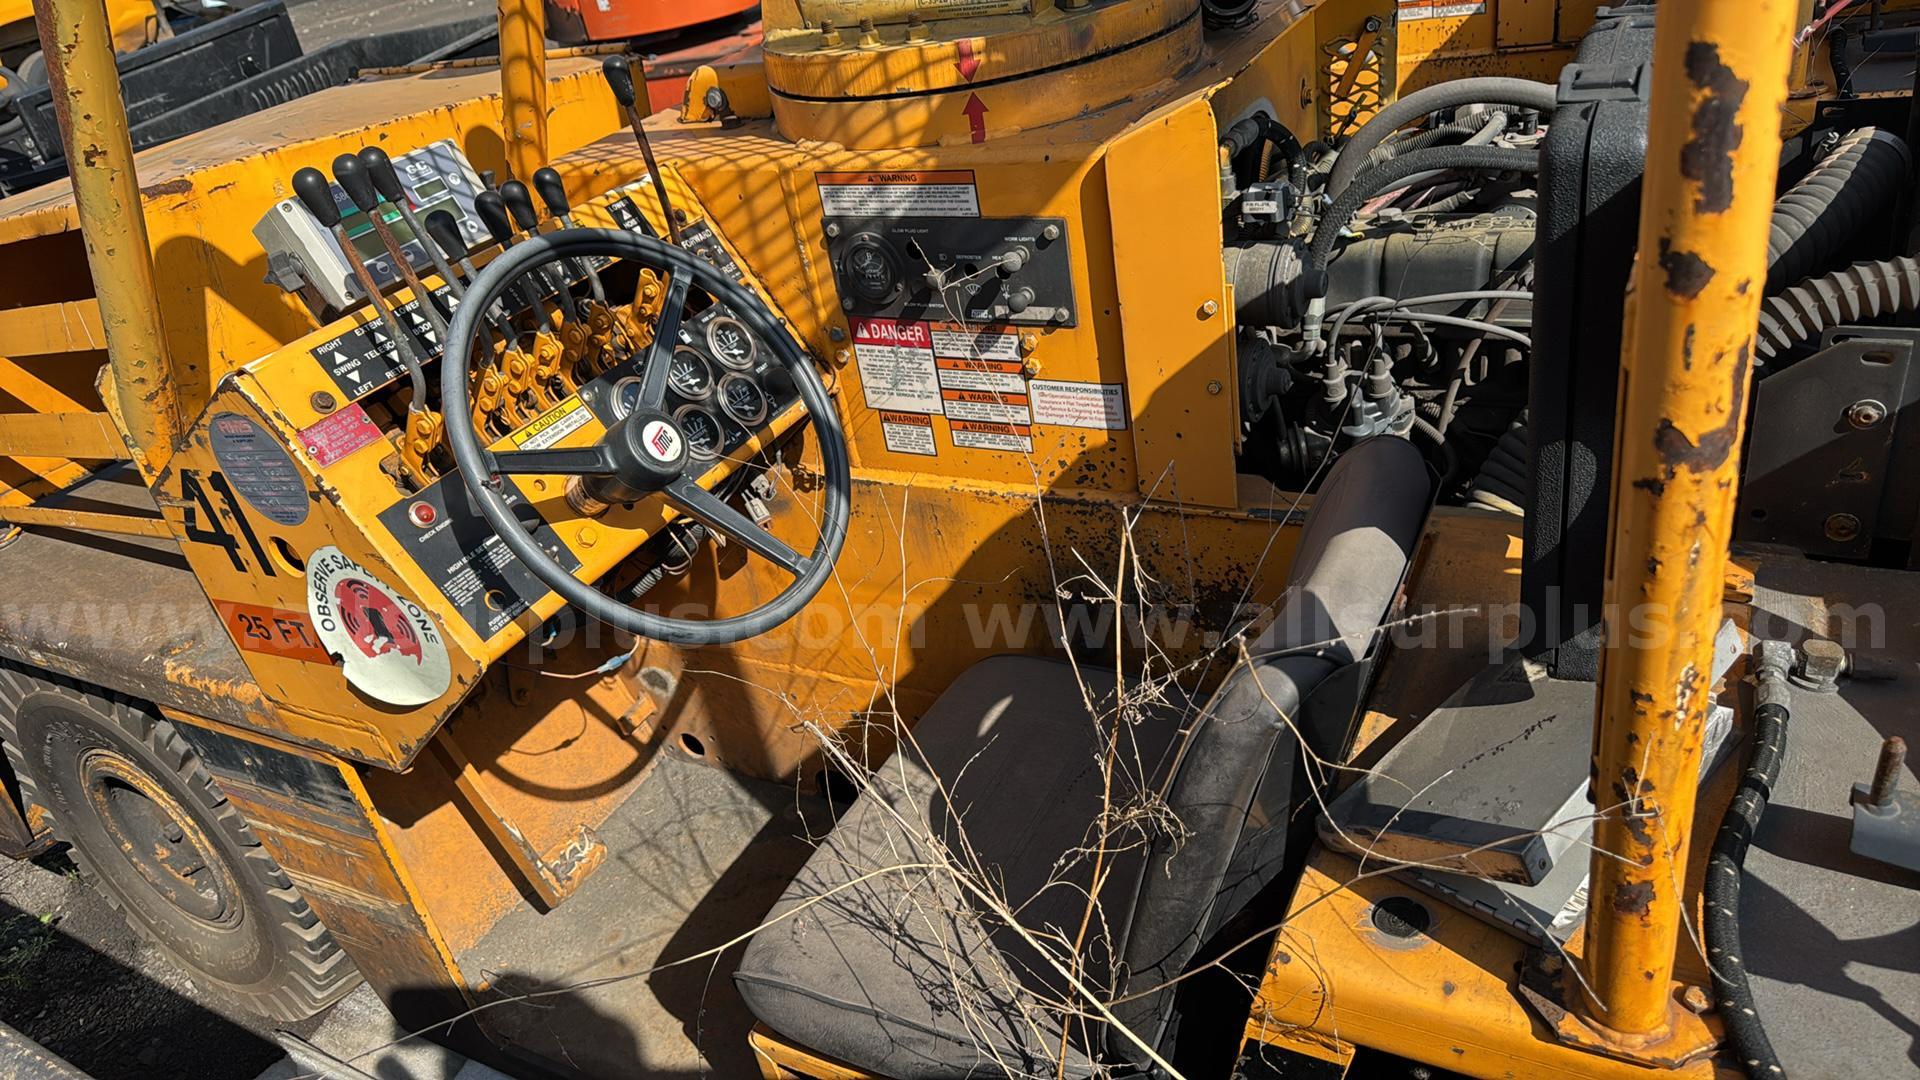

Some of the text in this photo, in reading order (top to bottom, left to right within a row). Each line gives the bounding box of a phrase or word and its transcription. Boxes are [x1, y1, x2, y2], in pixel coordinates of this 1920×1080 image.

[879, 174, 918, 182] WARNING
[870, 323, 925, 343] DANGER
[317, 338, 343, 355] RIGHT
[333, 358, 362, 377] SWING
[353, 381, 375, 397] LEFT
[1031, 384, 1119, 396] CUSTOMER RESPONSIBILITIES
[532, 407, 567, 432] CAUTION
[890, 414, 930, 425] WARNING
[969, 422, 1010, 433] WARNING
[180, 468, 277, 577] 41
[418, 528, 436, 543] CHECK
[447, 560, 464, 575] HIGH
[308, 558, 336, 632] OBSERVE
[237, 613, 273, 642] 25
